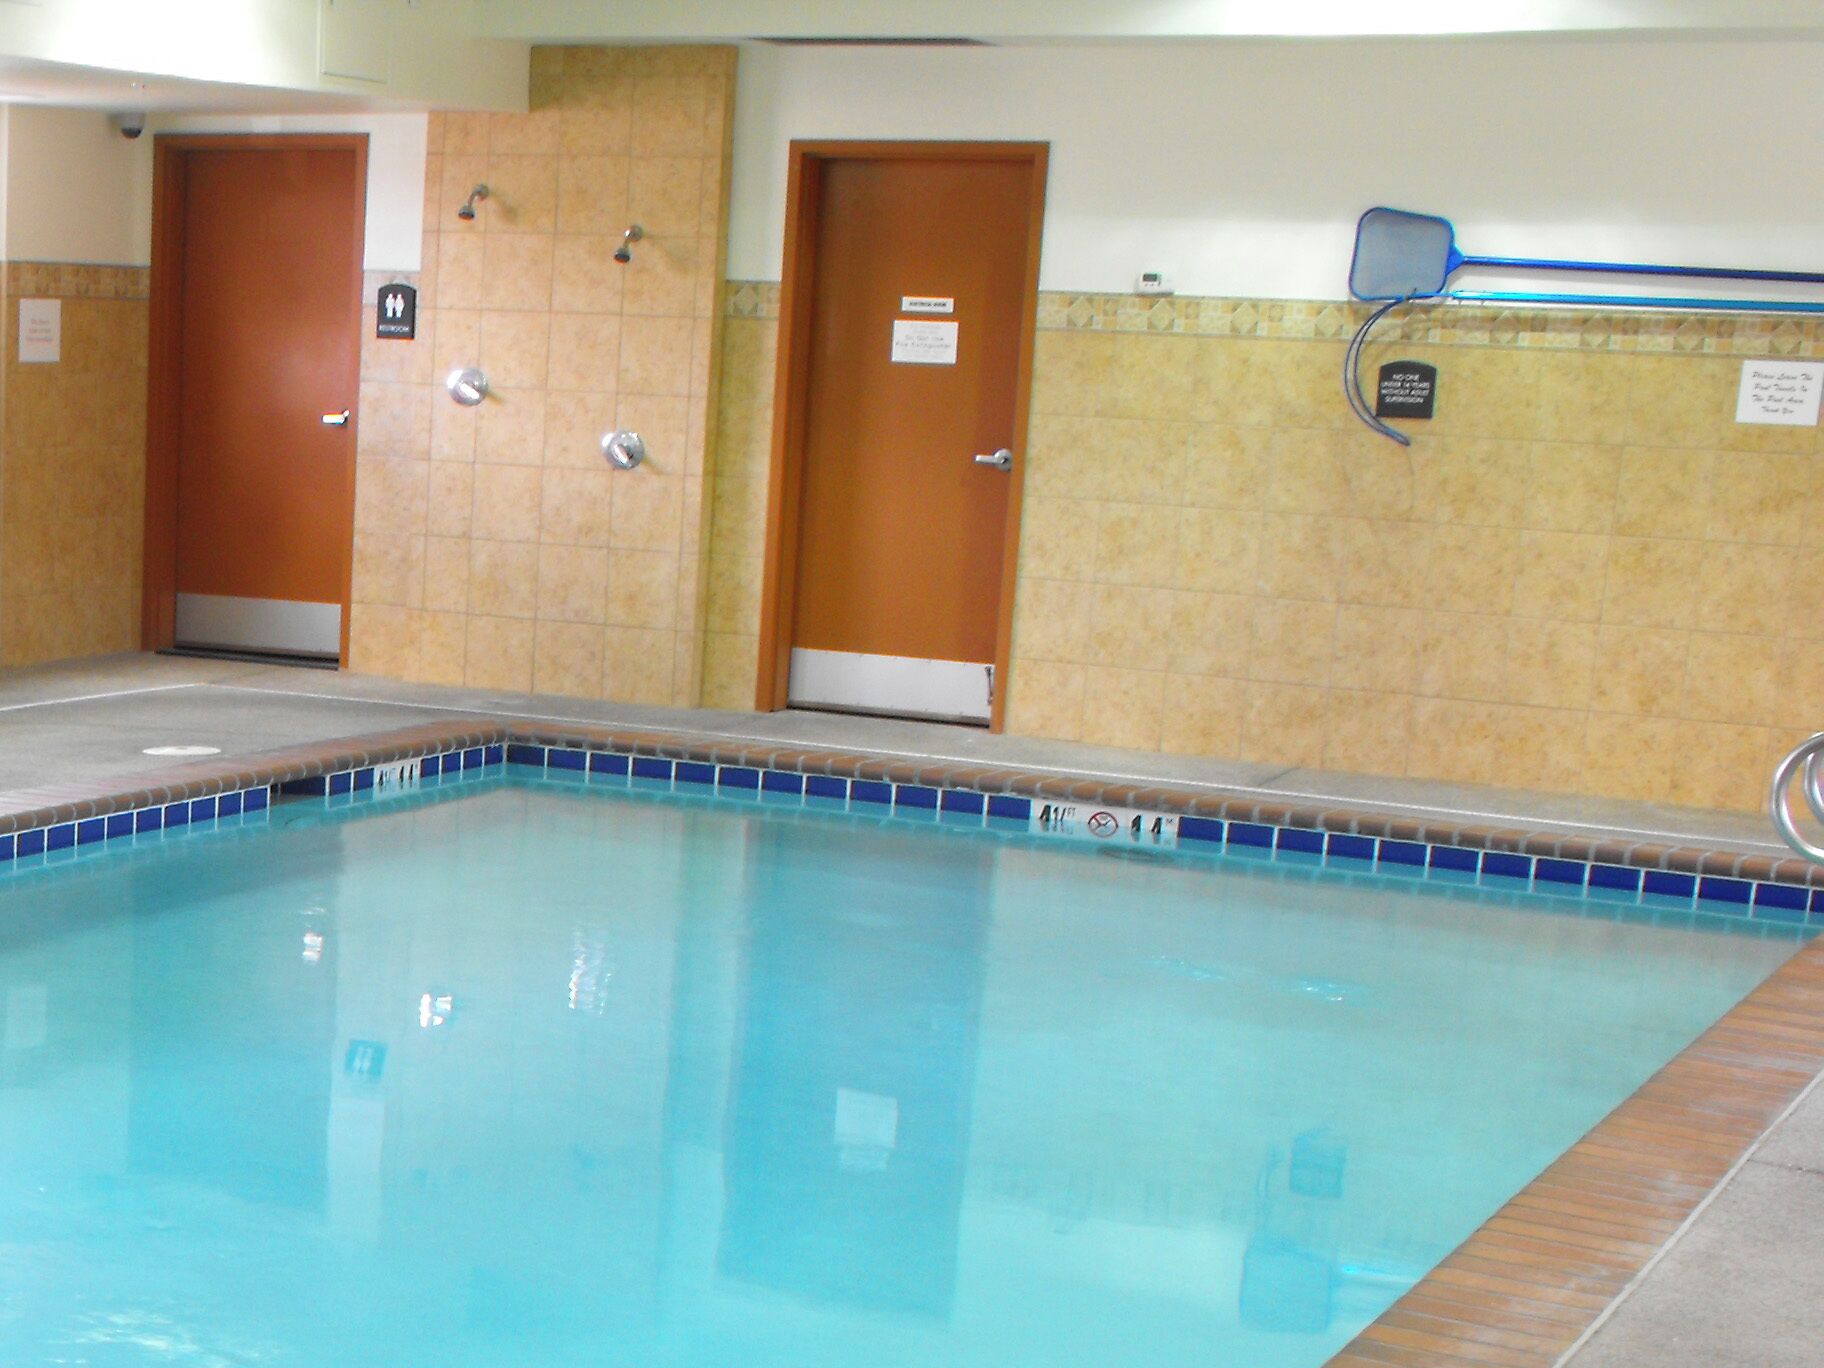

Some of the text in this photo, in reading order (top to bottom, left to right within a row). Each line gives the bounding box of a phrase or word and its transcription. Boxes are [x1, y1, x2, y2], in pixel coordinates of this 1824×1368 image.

[1752, 371, 1774, 379] Please
[1410, 389, 1430, 397] ADULT
[1384, 395, 1424, 403] SUPERVISION
[1752, 394, 1764, 402] The
